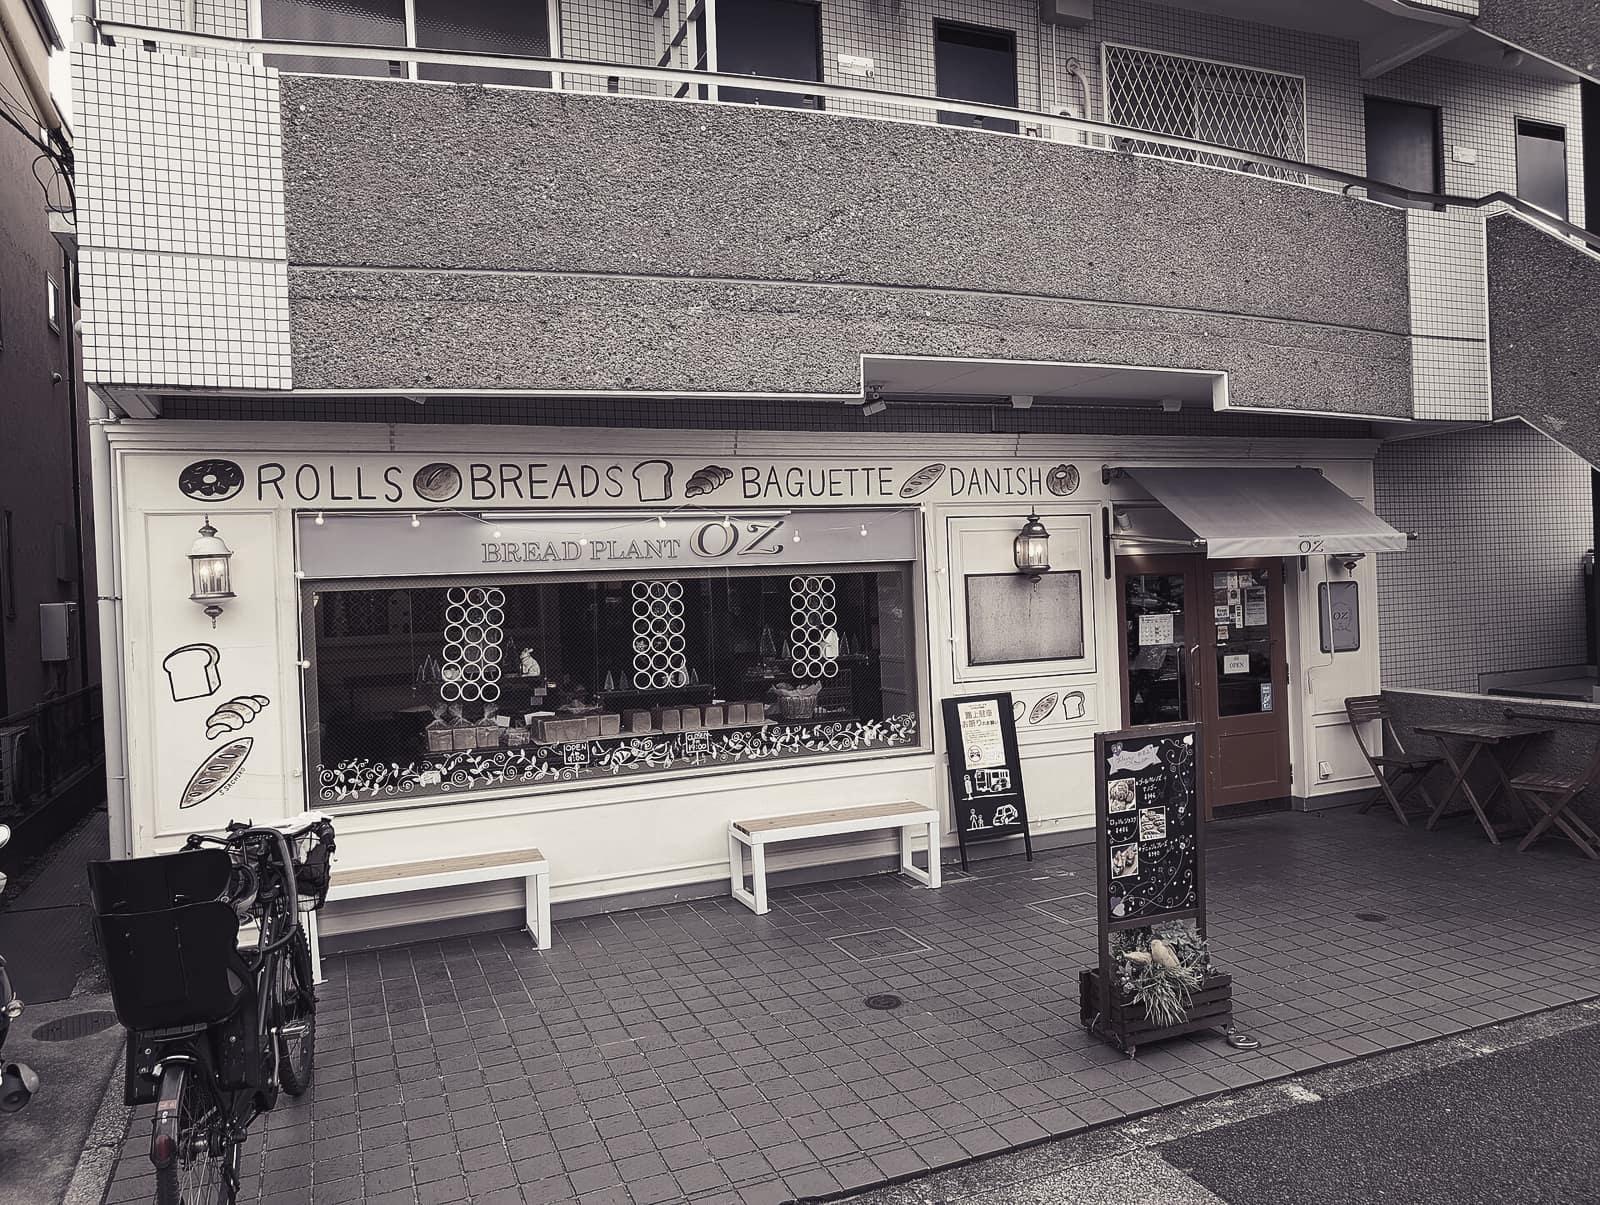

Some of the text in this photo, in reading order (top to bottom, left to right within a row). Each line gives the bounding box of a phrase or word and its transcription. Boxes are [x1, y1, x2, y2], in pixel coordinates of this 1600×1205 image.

[257, 462, 1043, 503] ROLLS BREADS BAGUETTE DANISH
[481, 520, 785, 563] BREAD PLANT OZ
[1299, 540, 1324, 553] OZ
[565, 743, 587, 752] OPEN
